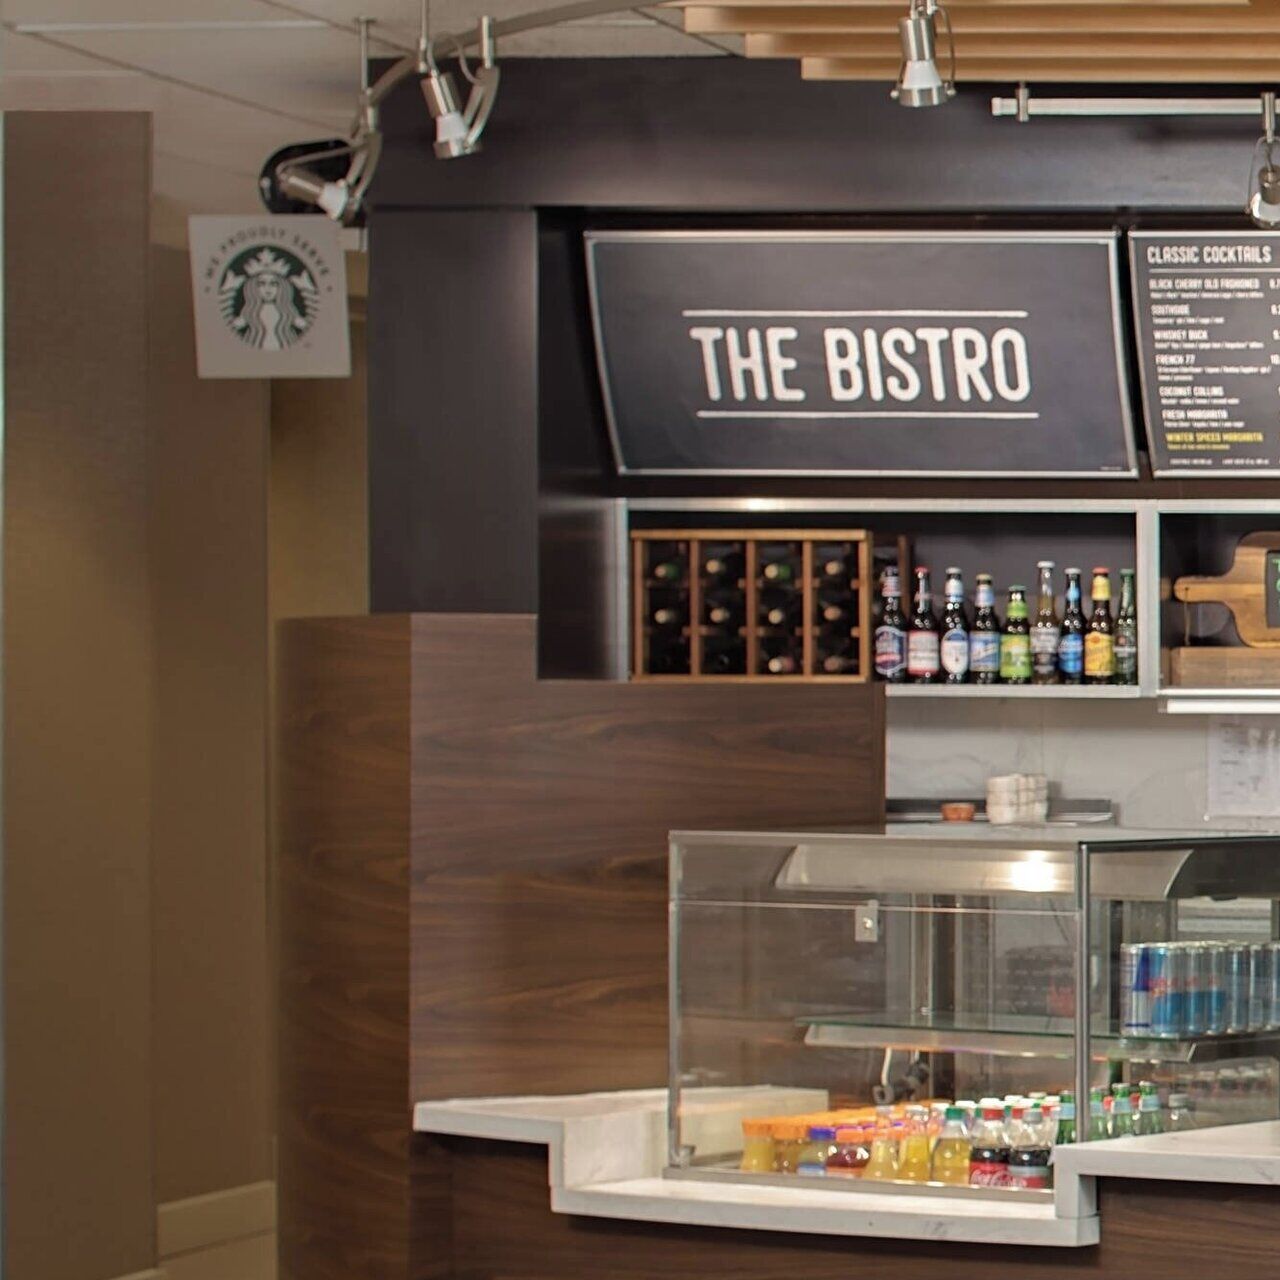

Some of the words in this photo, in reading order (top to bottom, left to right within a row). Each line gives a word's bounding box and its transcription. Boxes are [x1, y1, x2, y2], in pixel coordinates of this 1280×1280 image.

[1147, 246, 1199, 264] CLASSIC
[1203, 246, 1272, 264] COCKTAILS
[689, 327, 805, 401] THE
[824, 327, 1031, 402] BISTRO
